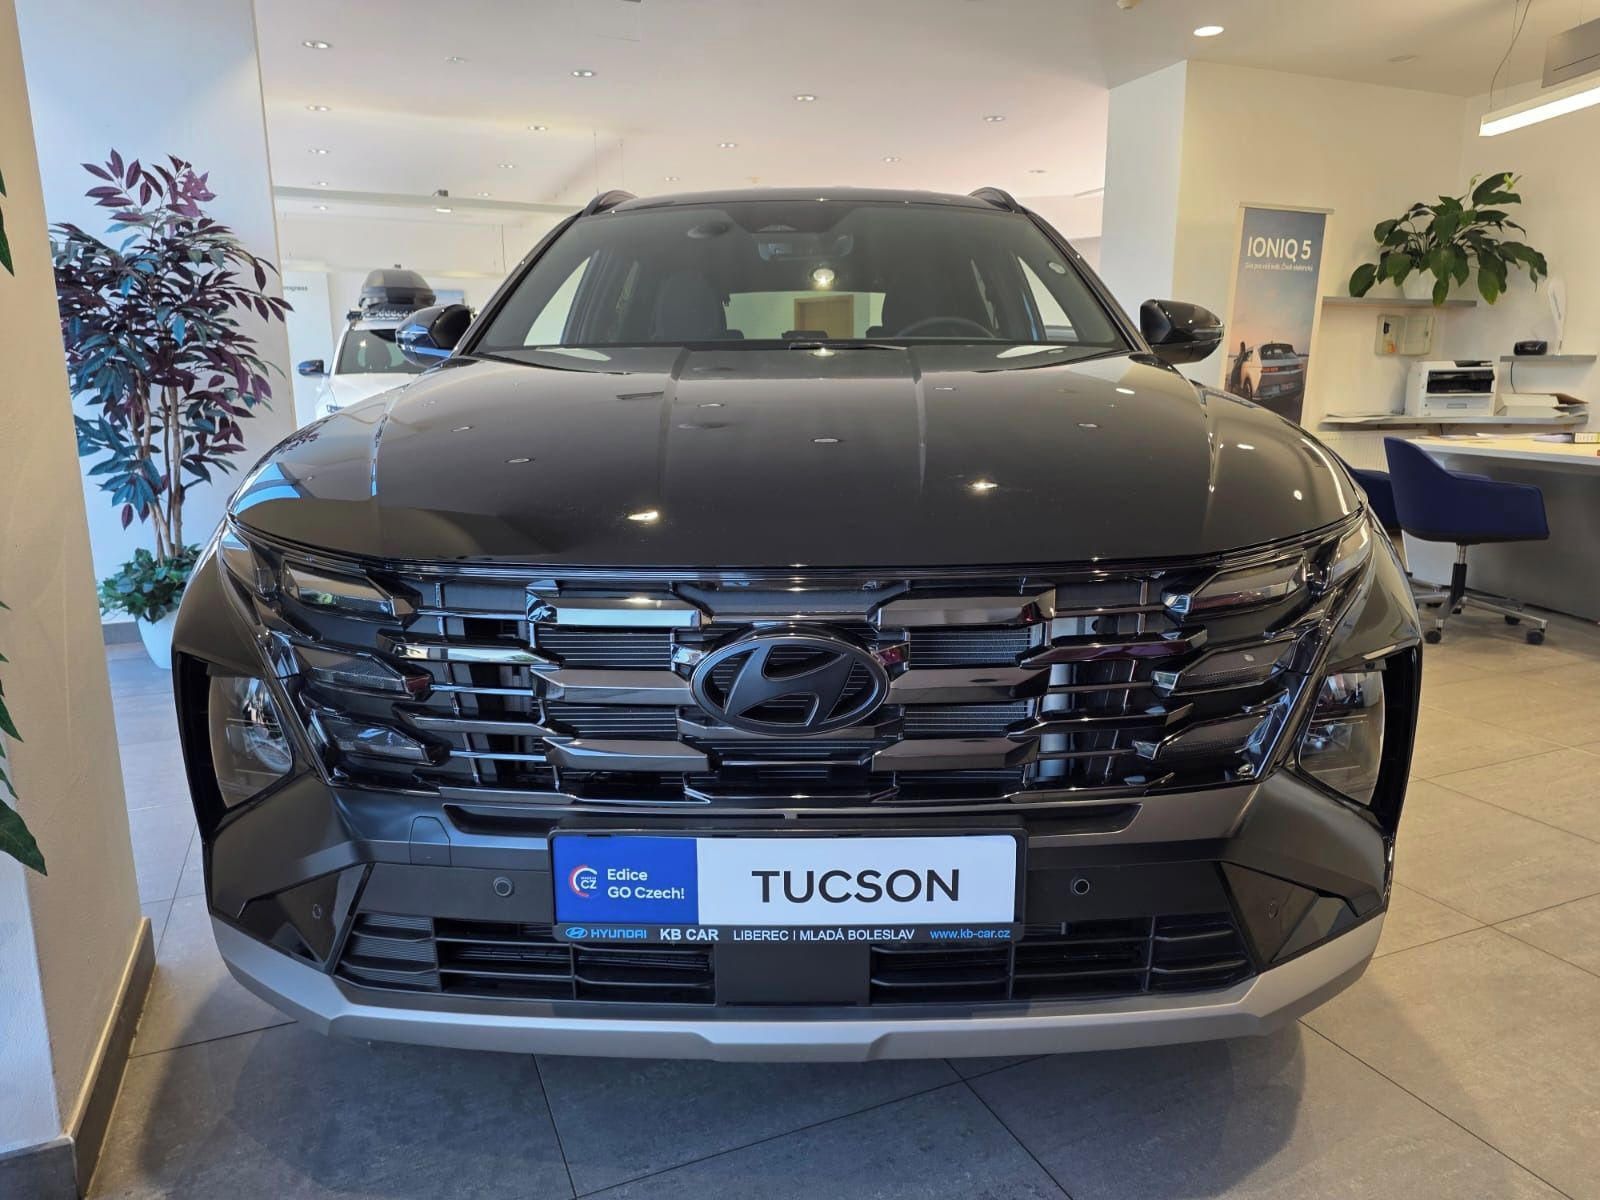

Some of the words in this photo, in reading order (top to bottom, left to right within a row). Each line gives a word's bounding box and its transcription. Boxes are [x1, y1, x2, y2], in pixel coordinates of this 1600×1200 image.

[1247, 236, 1298, 262] IONIQ
[1300, 239, 1312, 260] 5
[607, 868, 648, 880] Edice
[580, 880, 597, 889] CZ
[751, 869, 960, 903] TUCSON
[607, 886, 632, 899] GO
[634, 887, 685, 899] Czech!
[591, 929, 647, 939] HYUNDAI
[660, 928, 682, 941] KB
[686, 928, 719, 941] CAR
[733, 929, 789, 941] LIBEREC
[800, 927, 845, 941] MLADÁ
[848, 929, 915, 941] BOLESLAV
[930, 928, 1011, 940] www.kb-car.cz
